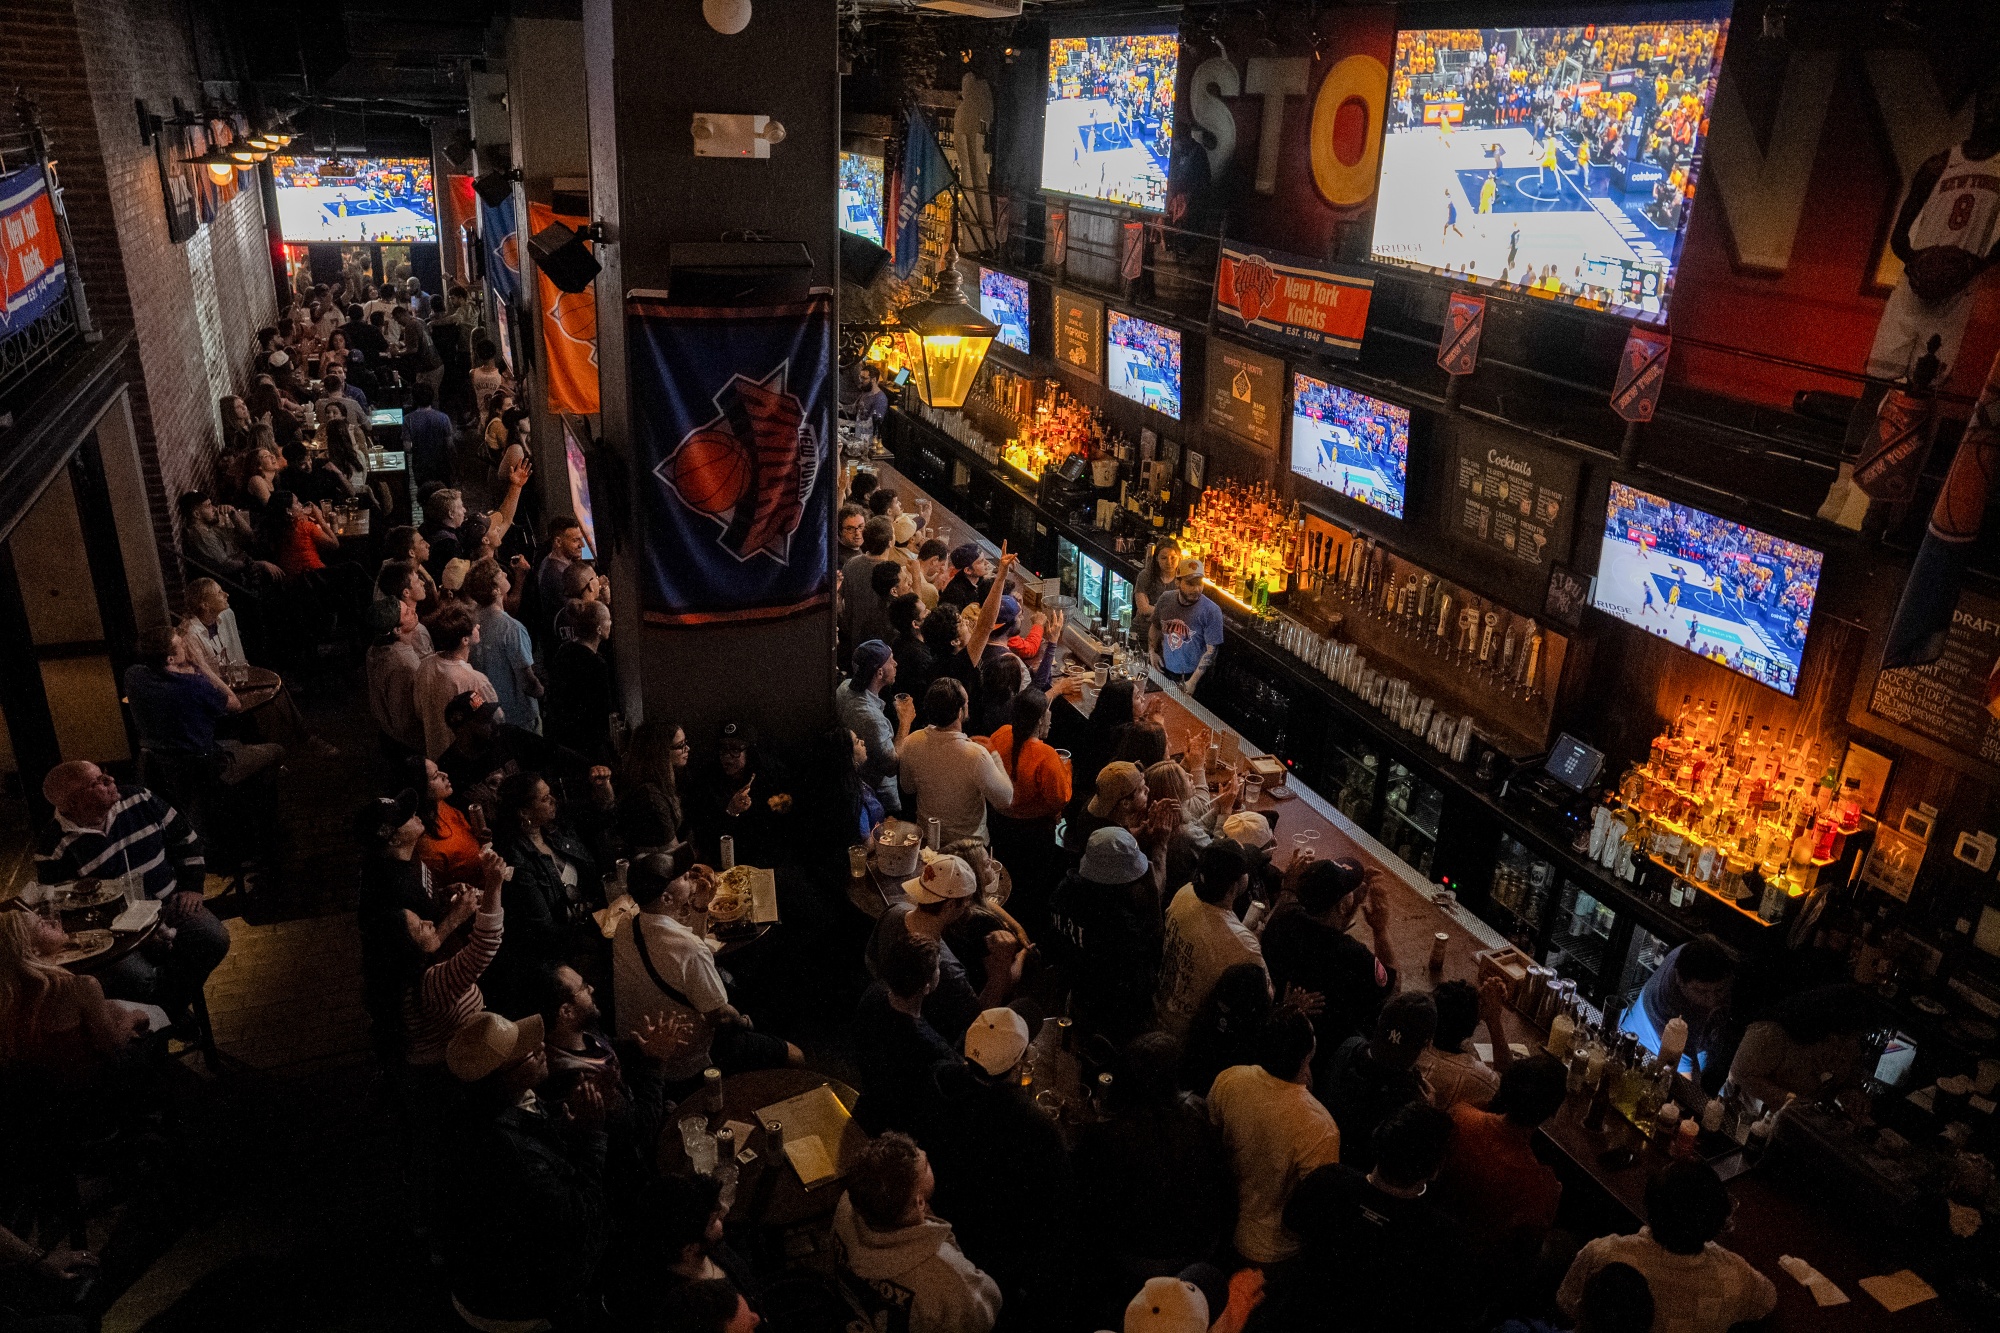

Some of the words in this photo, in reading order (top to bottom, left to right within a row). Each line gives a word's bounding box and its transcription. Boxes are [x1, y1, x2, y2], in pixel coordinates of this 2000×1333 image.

[1948, 193, 1976, 231] 8
[1283, 277, 1311, 301] New
[1312, 282, 1340, 308] York
[1286, 302, 1327, 329] Knicks
[1286, 326, 1300, 337] EST.
[800, 427, 816, 458] NEW
[1487, 448, 1532, 477] Cocktails
[1593, 600, 1632, 615] RIDGE
[1878, 680, 1916, 702] Dogfish
[1914, 697, 1945, 715] Head
[1881, 669, 1914, 690] DOC'S
[1915, 684, 1952, 707] CIDER
